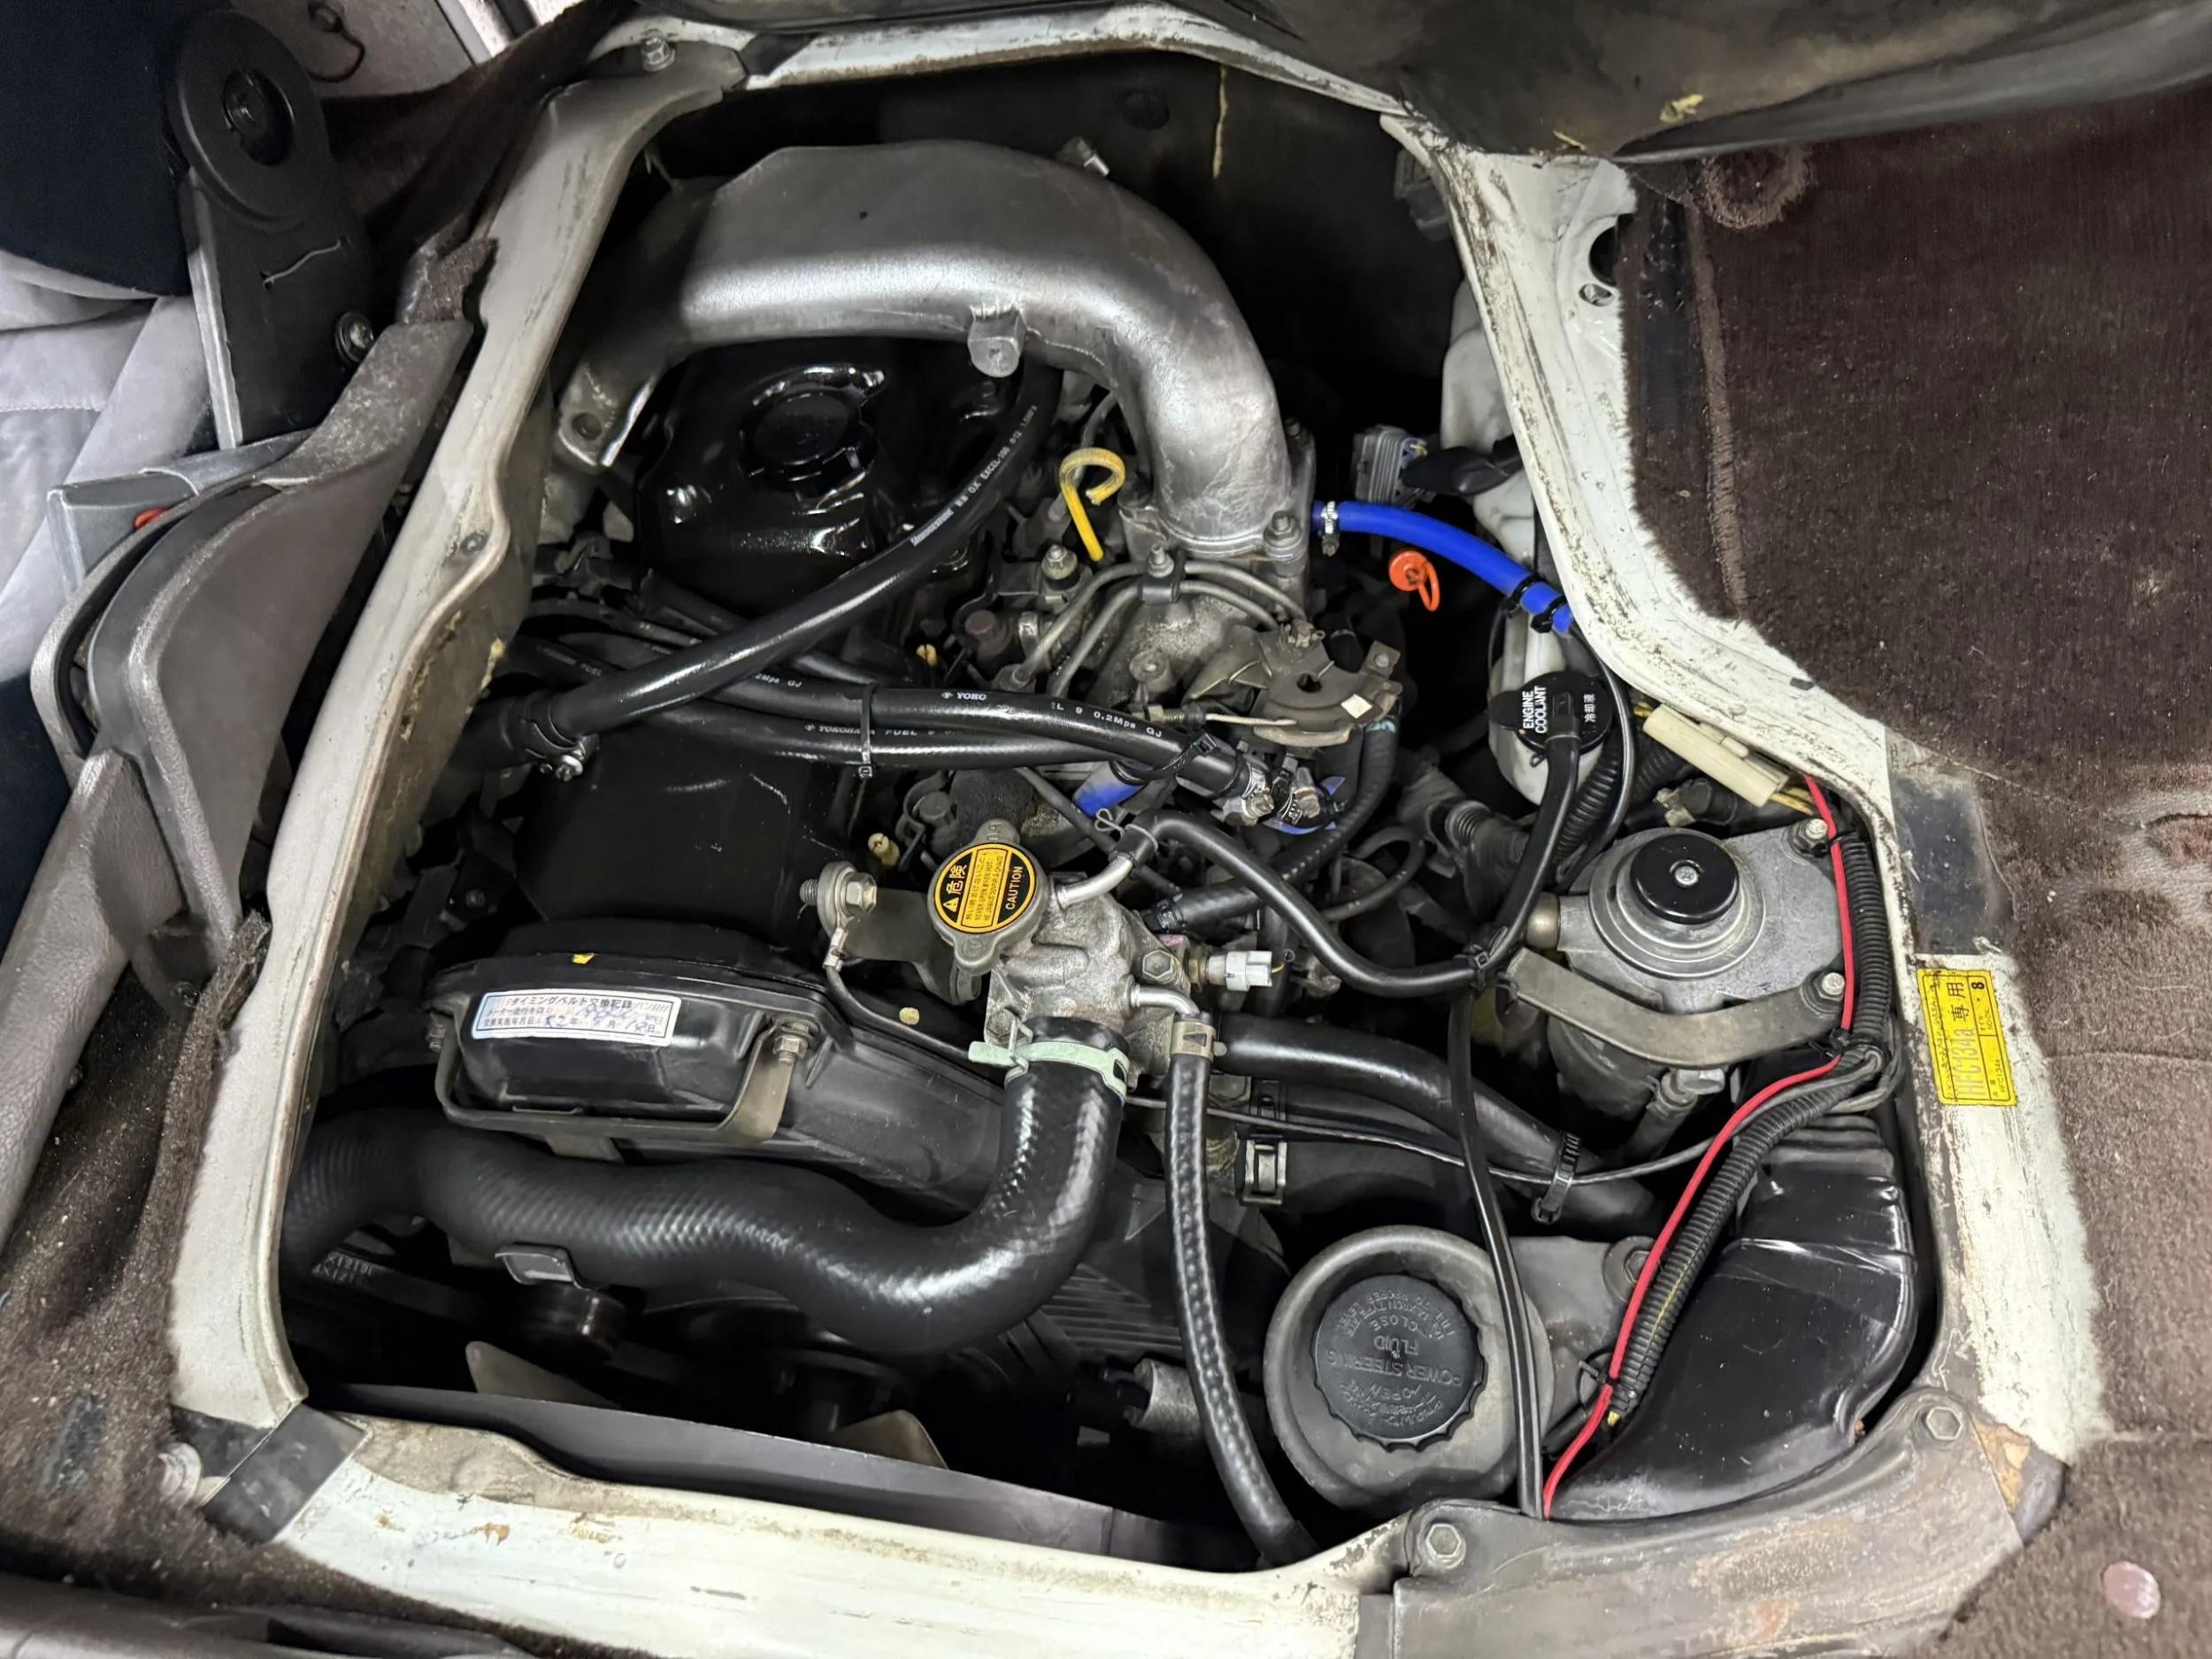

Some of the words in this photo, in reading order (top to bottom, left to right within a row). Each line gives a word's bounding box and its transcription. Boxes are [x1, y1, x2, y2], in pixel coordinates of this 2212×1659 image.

[1522, 690, 1534, 729] ENGINE
[1533, 685, 1548, 733] COOLANT
[1583, 693, 1596, 723] 冷却液
[818, 725, 875, 734] YOKOHAA
[1145, 726, 1163, 738] GJ
[945, 864, 968, 895] 危険
[1005, 865, 1024, 910] CAUTION
[1947, 981, 1970, 1022] 専用
[1953, 1028, 1985, 1096] HFC134a
[1370, 1314, 1417, 1333] CLOSE
[1373, 1335, 1419, 1356] FLUID
[1327, 1350, 1402, 1377] STEERING
[1406, 1364, 1463, 1387] POWER
[1369, 1384, 1413, 1402] OPEN
